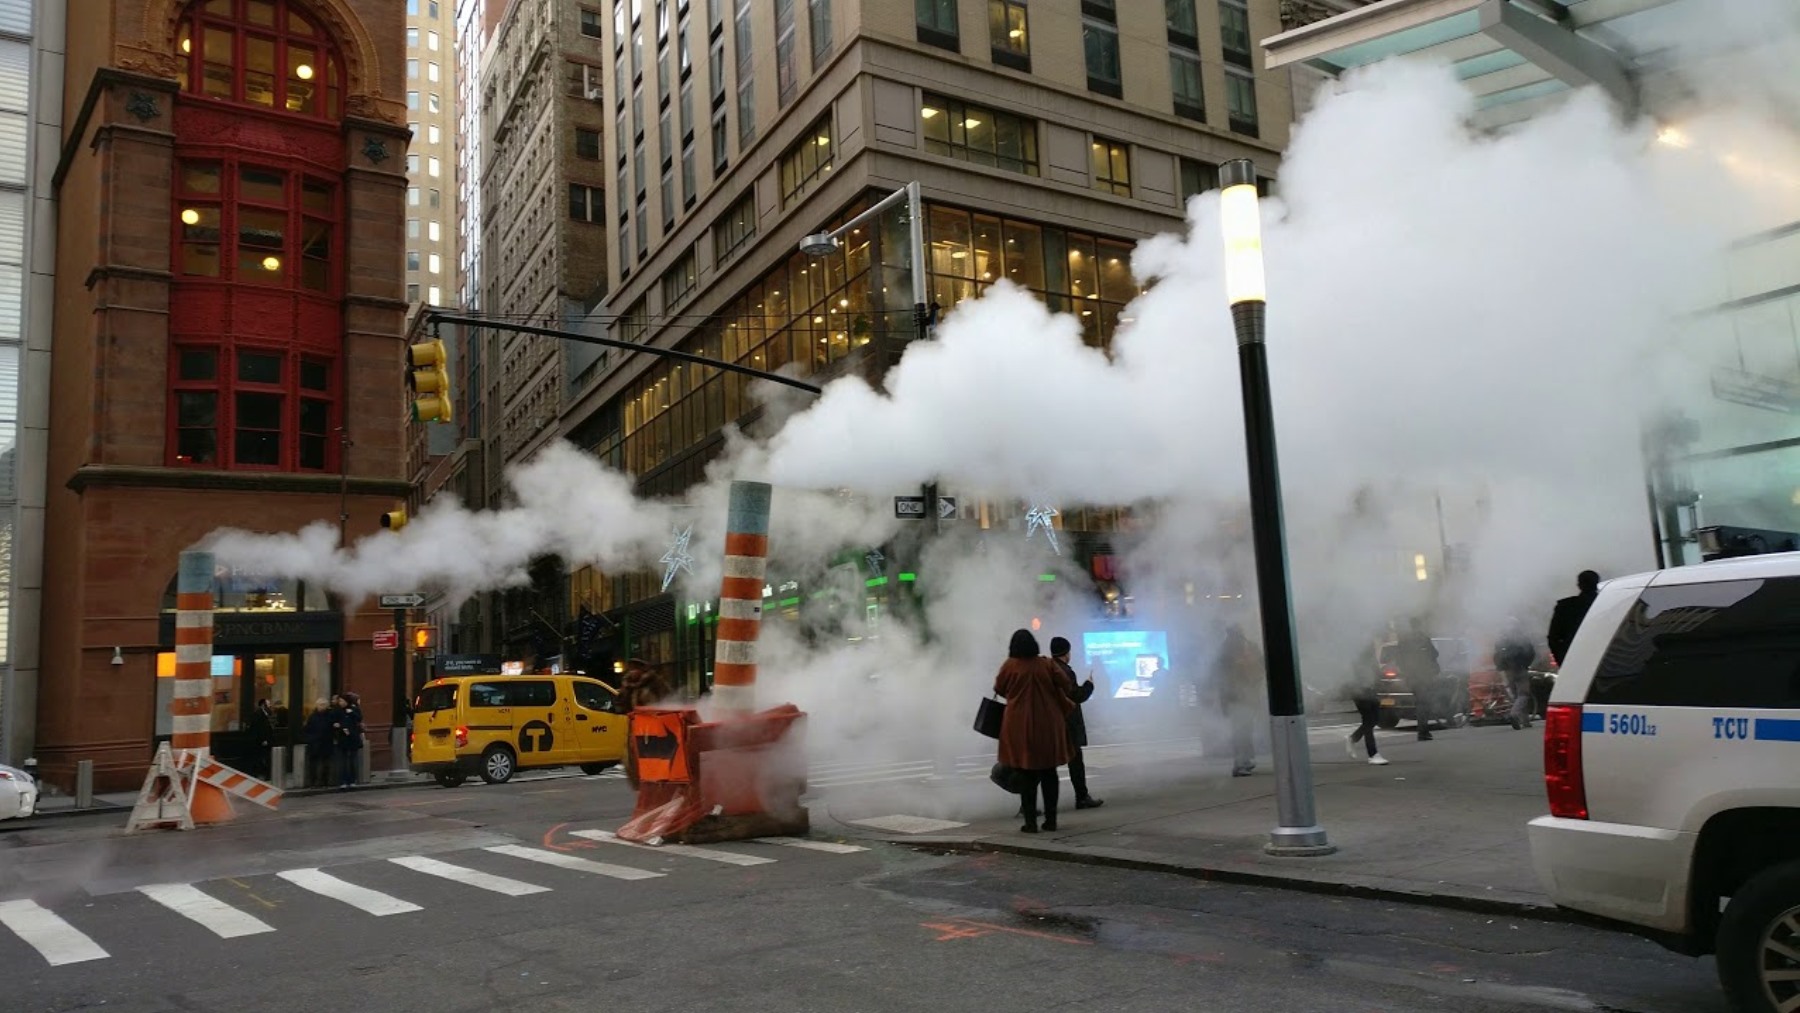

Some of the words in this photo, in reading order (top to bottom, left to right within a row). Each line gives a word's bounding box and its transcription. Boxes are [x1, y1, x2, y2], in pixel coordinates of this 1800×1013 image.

[900, 502, 919, 512] ONE
[592, 725, 607, 733] NYC
[1609, 714, 1646, 735] 5601
[1713, 717, 1749, 739] TCU
[526, 728, 546, 752] T
